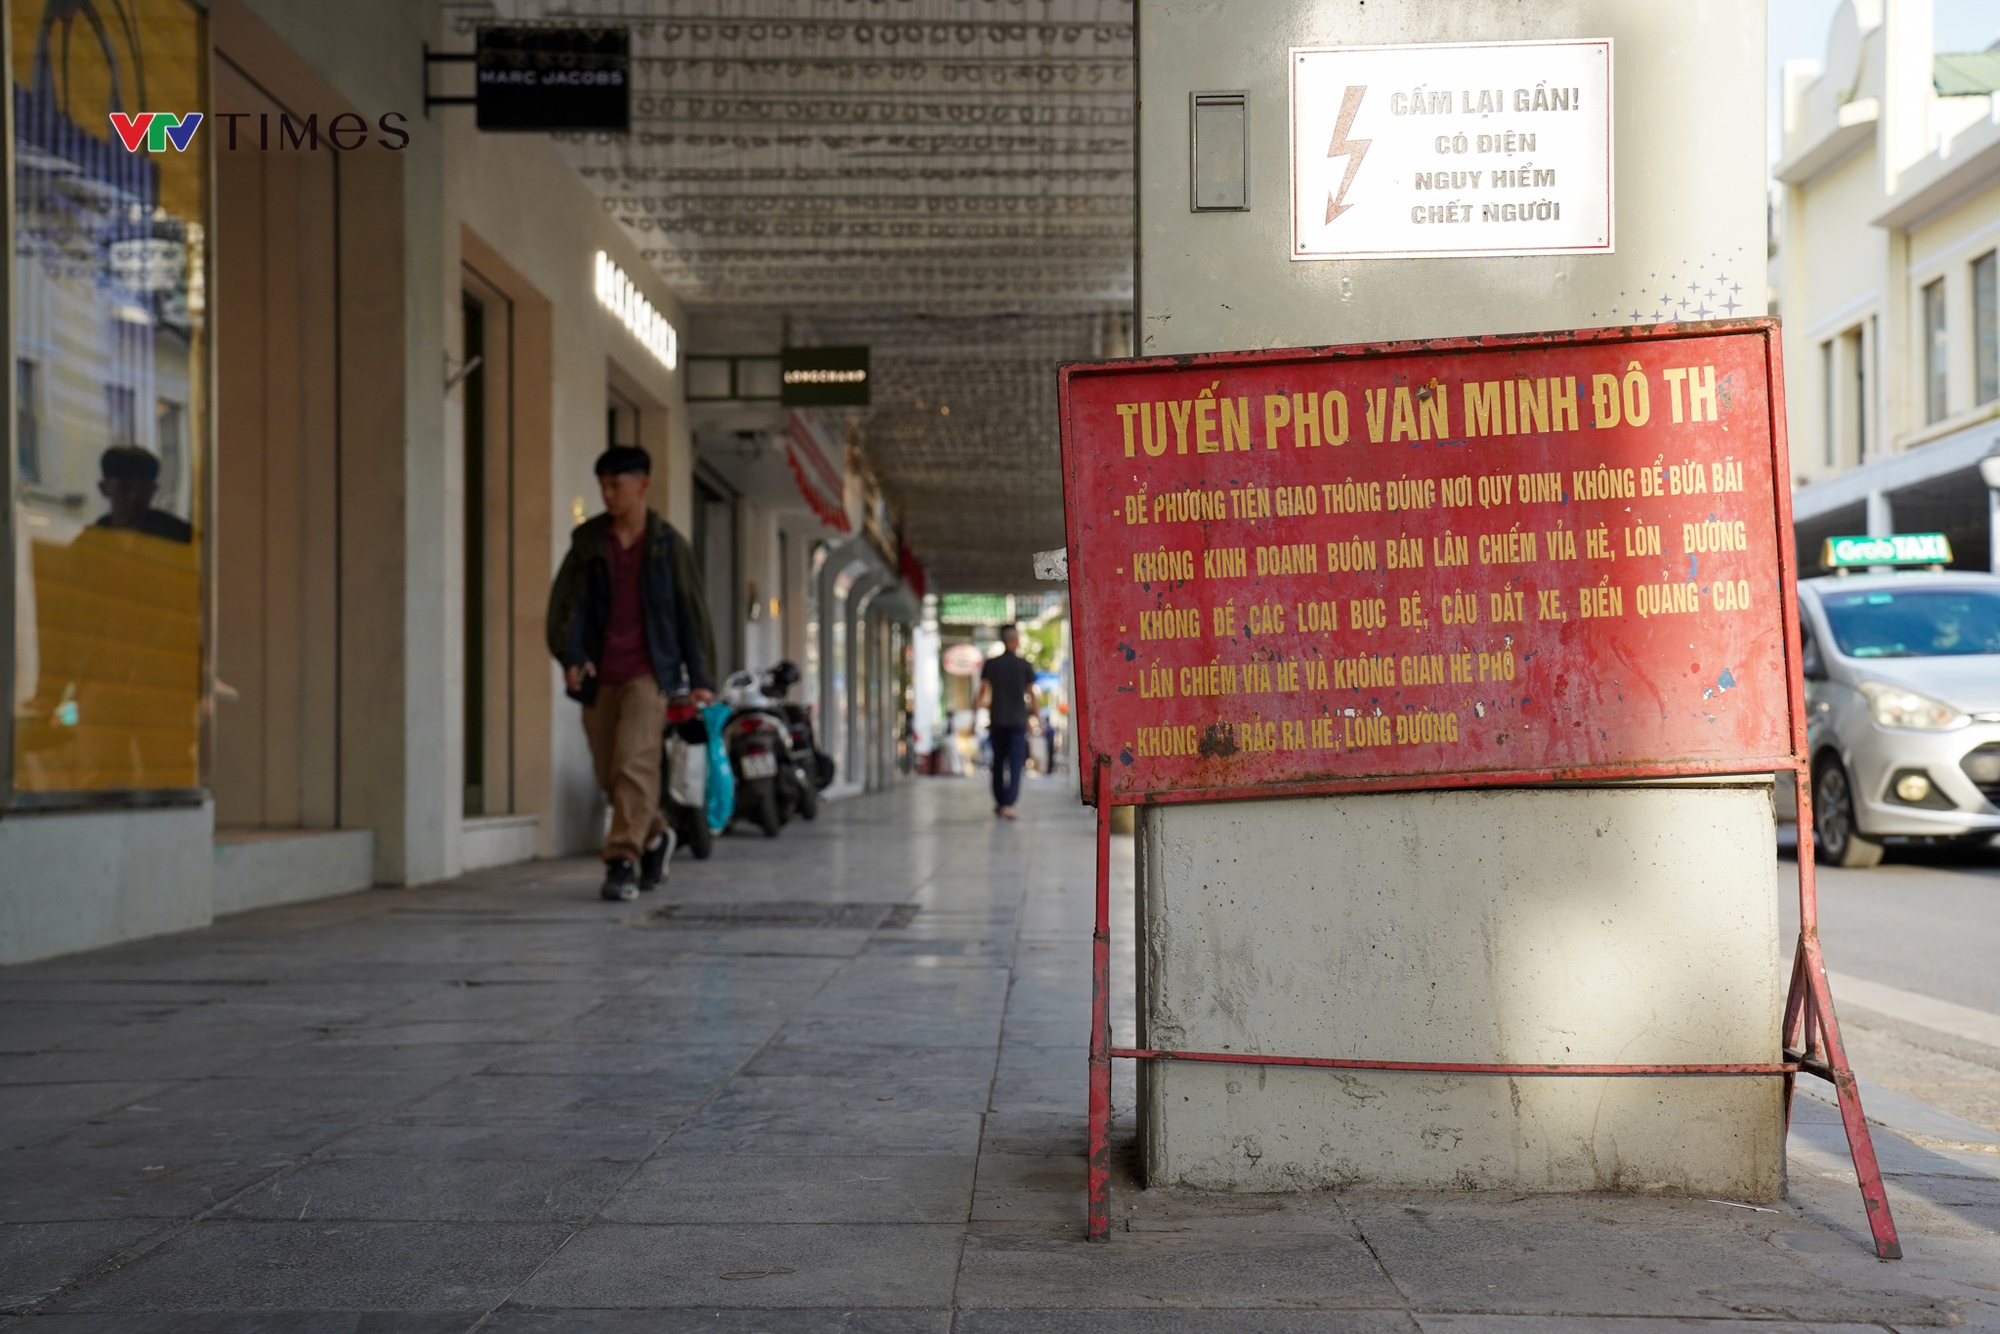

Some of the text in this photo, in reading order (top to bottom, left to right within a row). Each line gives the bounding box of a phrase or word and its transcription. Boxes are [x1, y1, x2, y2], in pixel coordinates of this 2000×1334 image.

[480, 70, 623, 85] MARC JACOBS
[1390, 80, 1580, 118] CẤM LẠI GẦN!
[1435, 130, 1537, 157] CÓ ĐIỆN
[1415, 162, 1556, 191] NGUY HIỂM
[1411, 198, 1561, 225] CHẾT NGƯỜI
[1116, 381, 1251, 457] TUYẾN
[1463, 376, 1579, 437] MINH
[1592, 360, 1651, 429] ĐÔ
[1125, 482, 1149, 525] ĐỂ
[1154, 488, 1226, 523] PHƯƠNG
[1230, 482, 1271, 525] TIỆN
[1276, 485, 1318, 517] GIAO
[1321, 476, 1382, 514] THÔNG
[1386, 474, 1436, 511] ĐÚNG
[1441, 474, 1473, 508] NƠI
[1478, 474, 1513, 509] QUY
[1572, 463, 1636, 501] KHÔNG
[1640, 454, 1665, 498] ĐỂ
[1669, 458, 1708, 495] BỪA
[1711, 455, 1744, 493] BÃI
[1133, 545, 1195, 583] KHÔNG
[1203, 547, 1248, 579] KINH
[1255, 543, 1318, 576] DOANH
[1327, 535, 1377, 573] BUÔN
[1386, 532, 1424, 570] BÁN
[1478, 522, 1538, 564] CHIẾM
[1585, 522, 1616, 562] HÈ,
[1139, 603, 1201, 641] KHÔNG
[1249, 598, 1286, 635] CÁC
[1297, 600, 1338, 638] LOẠI
[1350, 598, 1387, 636] BỤC
[1399, 590, 1429, 634] BỆ,
[1441, 588, 1478, 625] CÂU
[1537, 589, 1567, 623] XE,
[1579, 575, 1623, 619] BIỂN
[1636, 570, 1699, 619] QUẢNG
[1712, 579, 1750, 612] CAO
[1139, 657, 1174, 699] LẤN
[1179, 654, 1237, 697] CHIẾM
[1277, 655, 1301, 692] HÈ
[1305, 653, 1329, 691] VÀ
[1333, 651, 1396, 689] KHÔNG
[1401, 652, 1445, 686] GIAN
[1450, 646, 1473, 683] HÈ
[1478, 639, 1515, 682] PHỐ
[1136, 719, 1198, 757] KHÔNG
[1241, 710, 1277, 753] RÁC
[1282, 719, 1307, 751] RA
[1311, 712, 1340, 753] HÈ,
[1344, 709, 1392, 748] LÒNG
[1397, 705, 1459, 744] ĐƯỜNG
